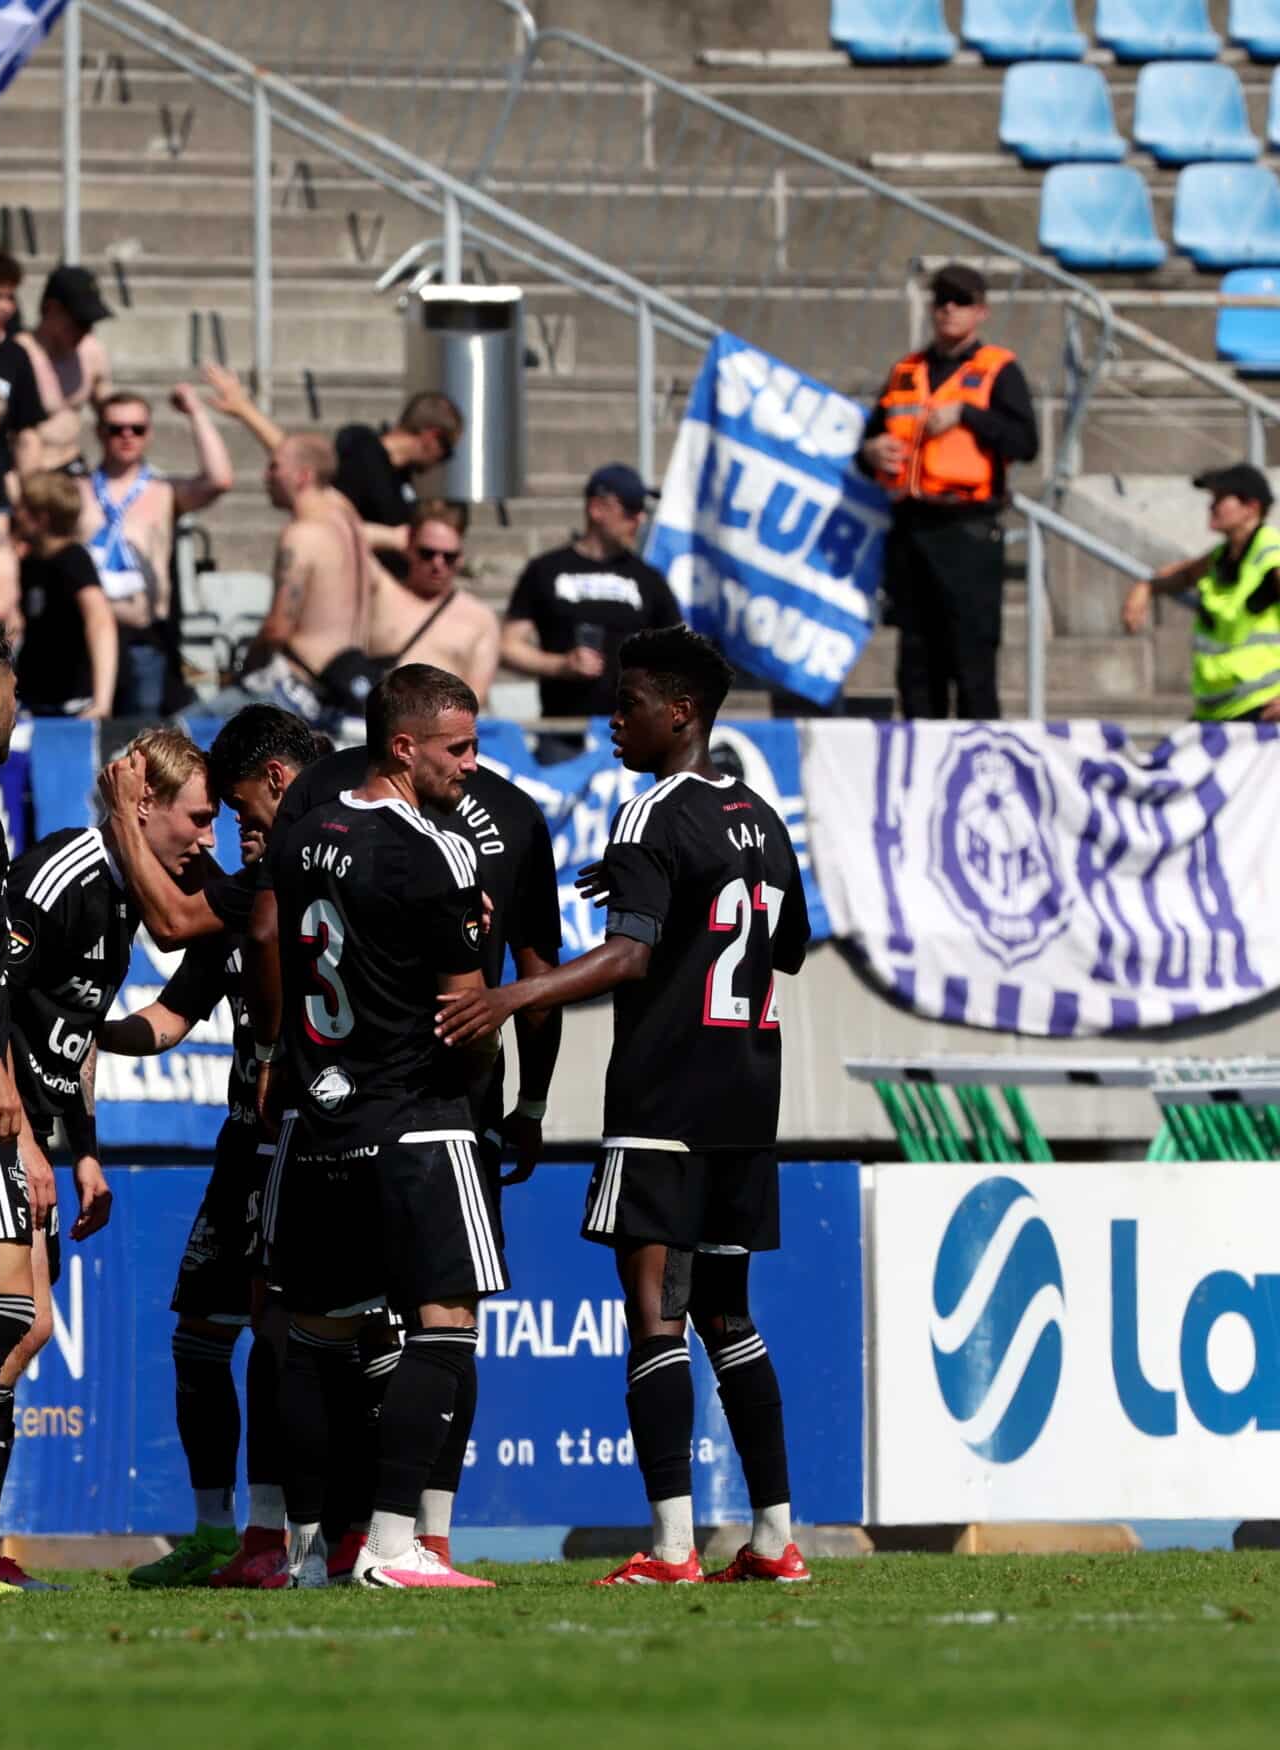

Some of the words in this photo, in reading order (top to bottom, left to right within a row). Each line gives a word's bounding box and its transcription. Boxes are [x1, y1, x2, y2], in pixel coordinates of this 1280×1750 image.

[456, 794, 505, 855] NUTO
[302, 843, 352, 878] SANS
[299, 899, 356, 1046] 3
[497, 1438, 535, 1467] on
